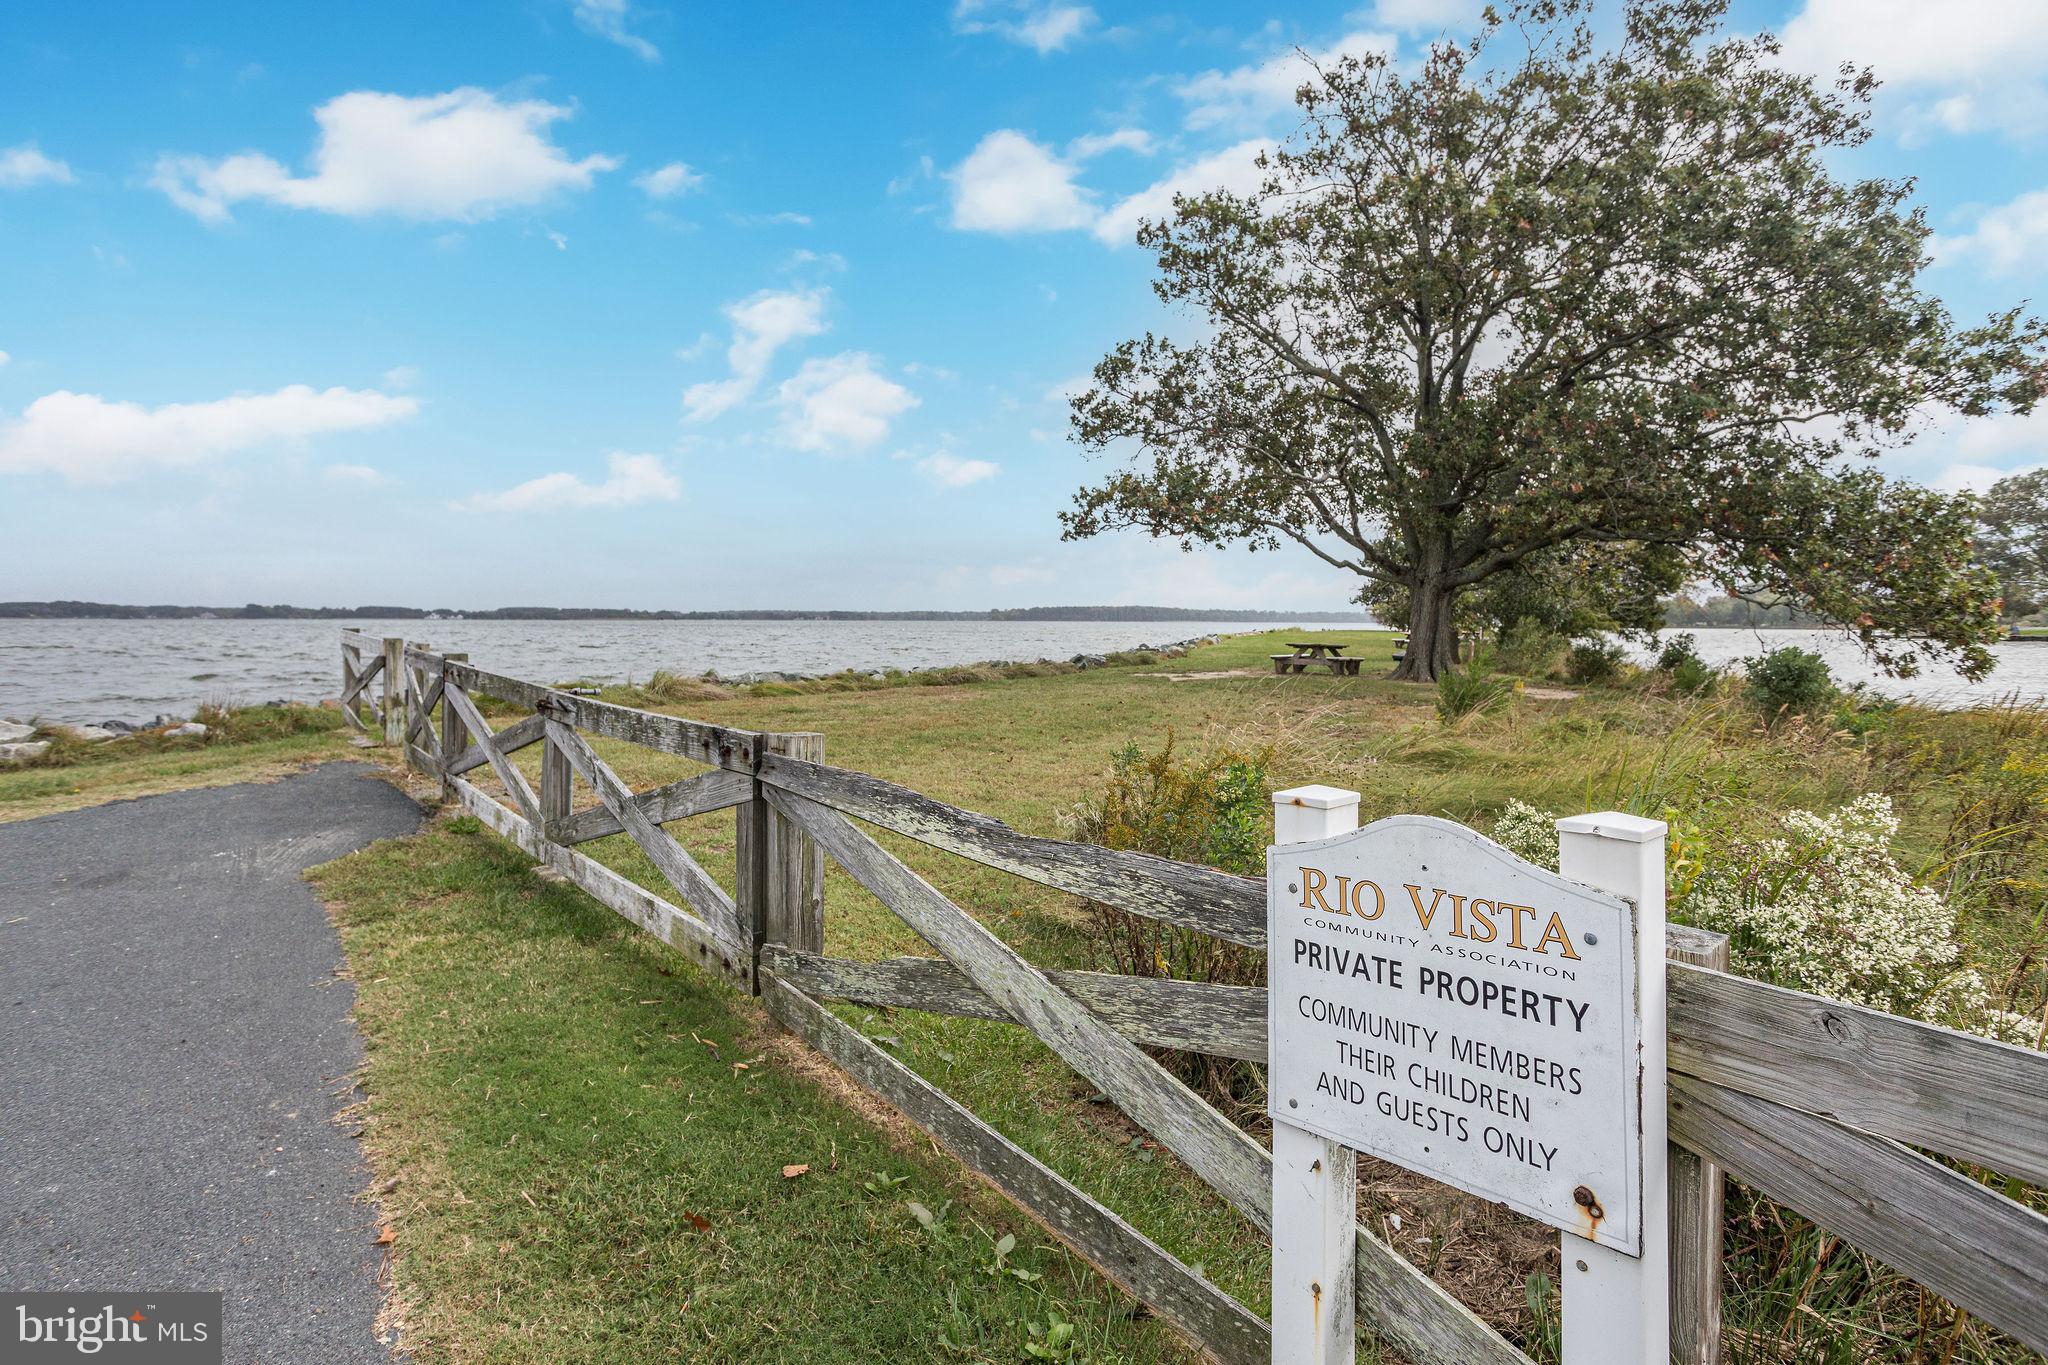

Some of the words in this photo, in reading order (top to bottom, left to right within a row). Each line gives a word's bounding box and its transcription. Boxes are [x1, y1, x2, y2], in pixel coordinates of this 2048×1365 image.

[1298, 866, 1386, 921] RIO
[1404, 883, 1582, 961] VISTA
[1303, 917, 1420, 948] COMMUNITY
[1430, 943, 1576, 981] ASSOCIATION
[1294, 938, 1403, 989] PRIVATE
[1420, 967, 1590, 1032] PROPERTY
[1298, 995, 1438, 1053] COMMUNITY
[1451, 1036, 1582, 1094] MEMBERS
[1336, 1040, 1395, 1080] THEIR
[1408, 1063, 1530, 1122] CHILDREN
[1316, 1072, 1364, 1105] AND
[1376, 1092, 1468, 1142] GUESTS
[1483, 1126, 1558, 1171] ONLY
